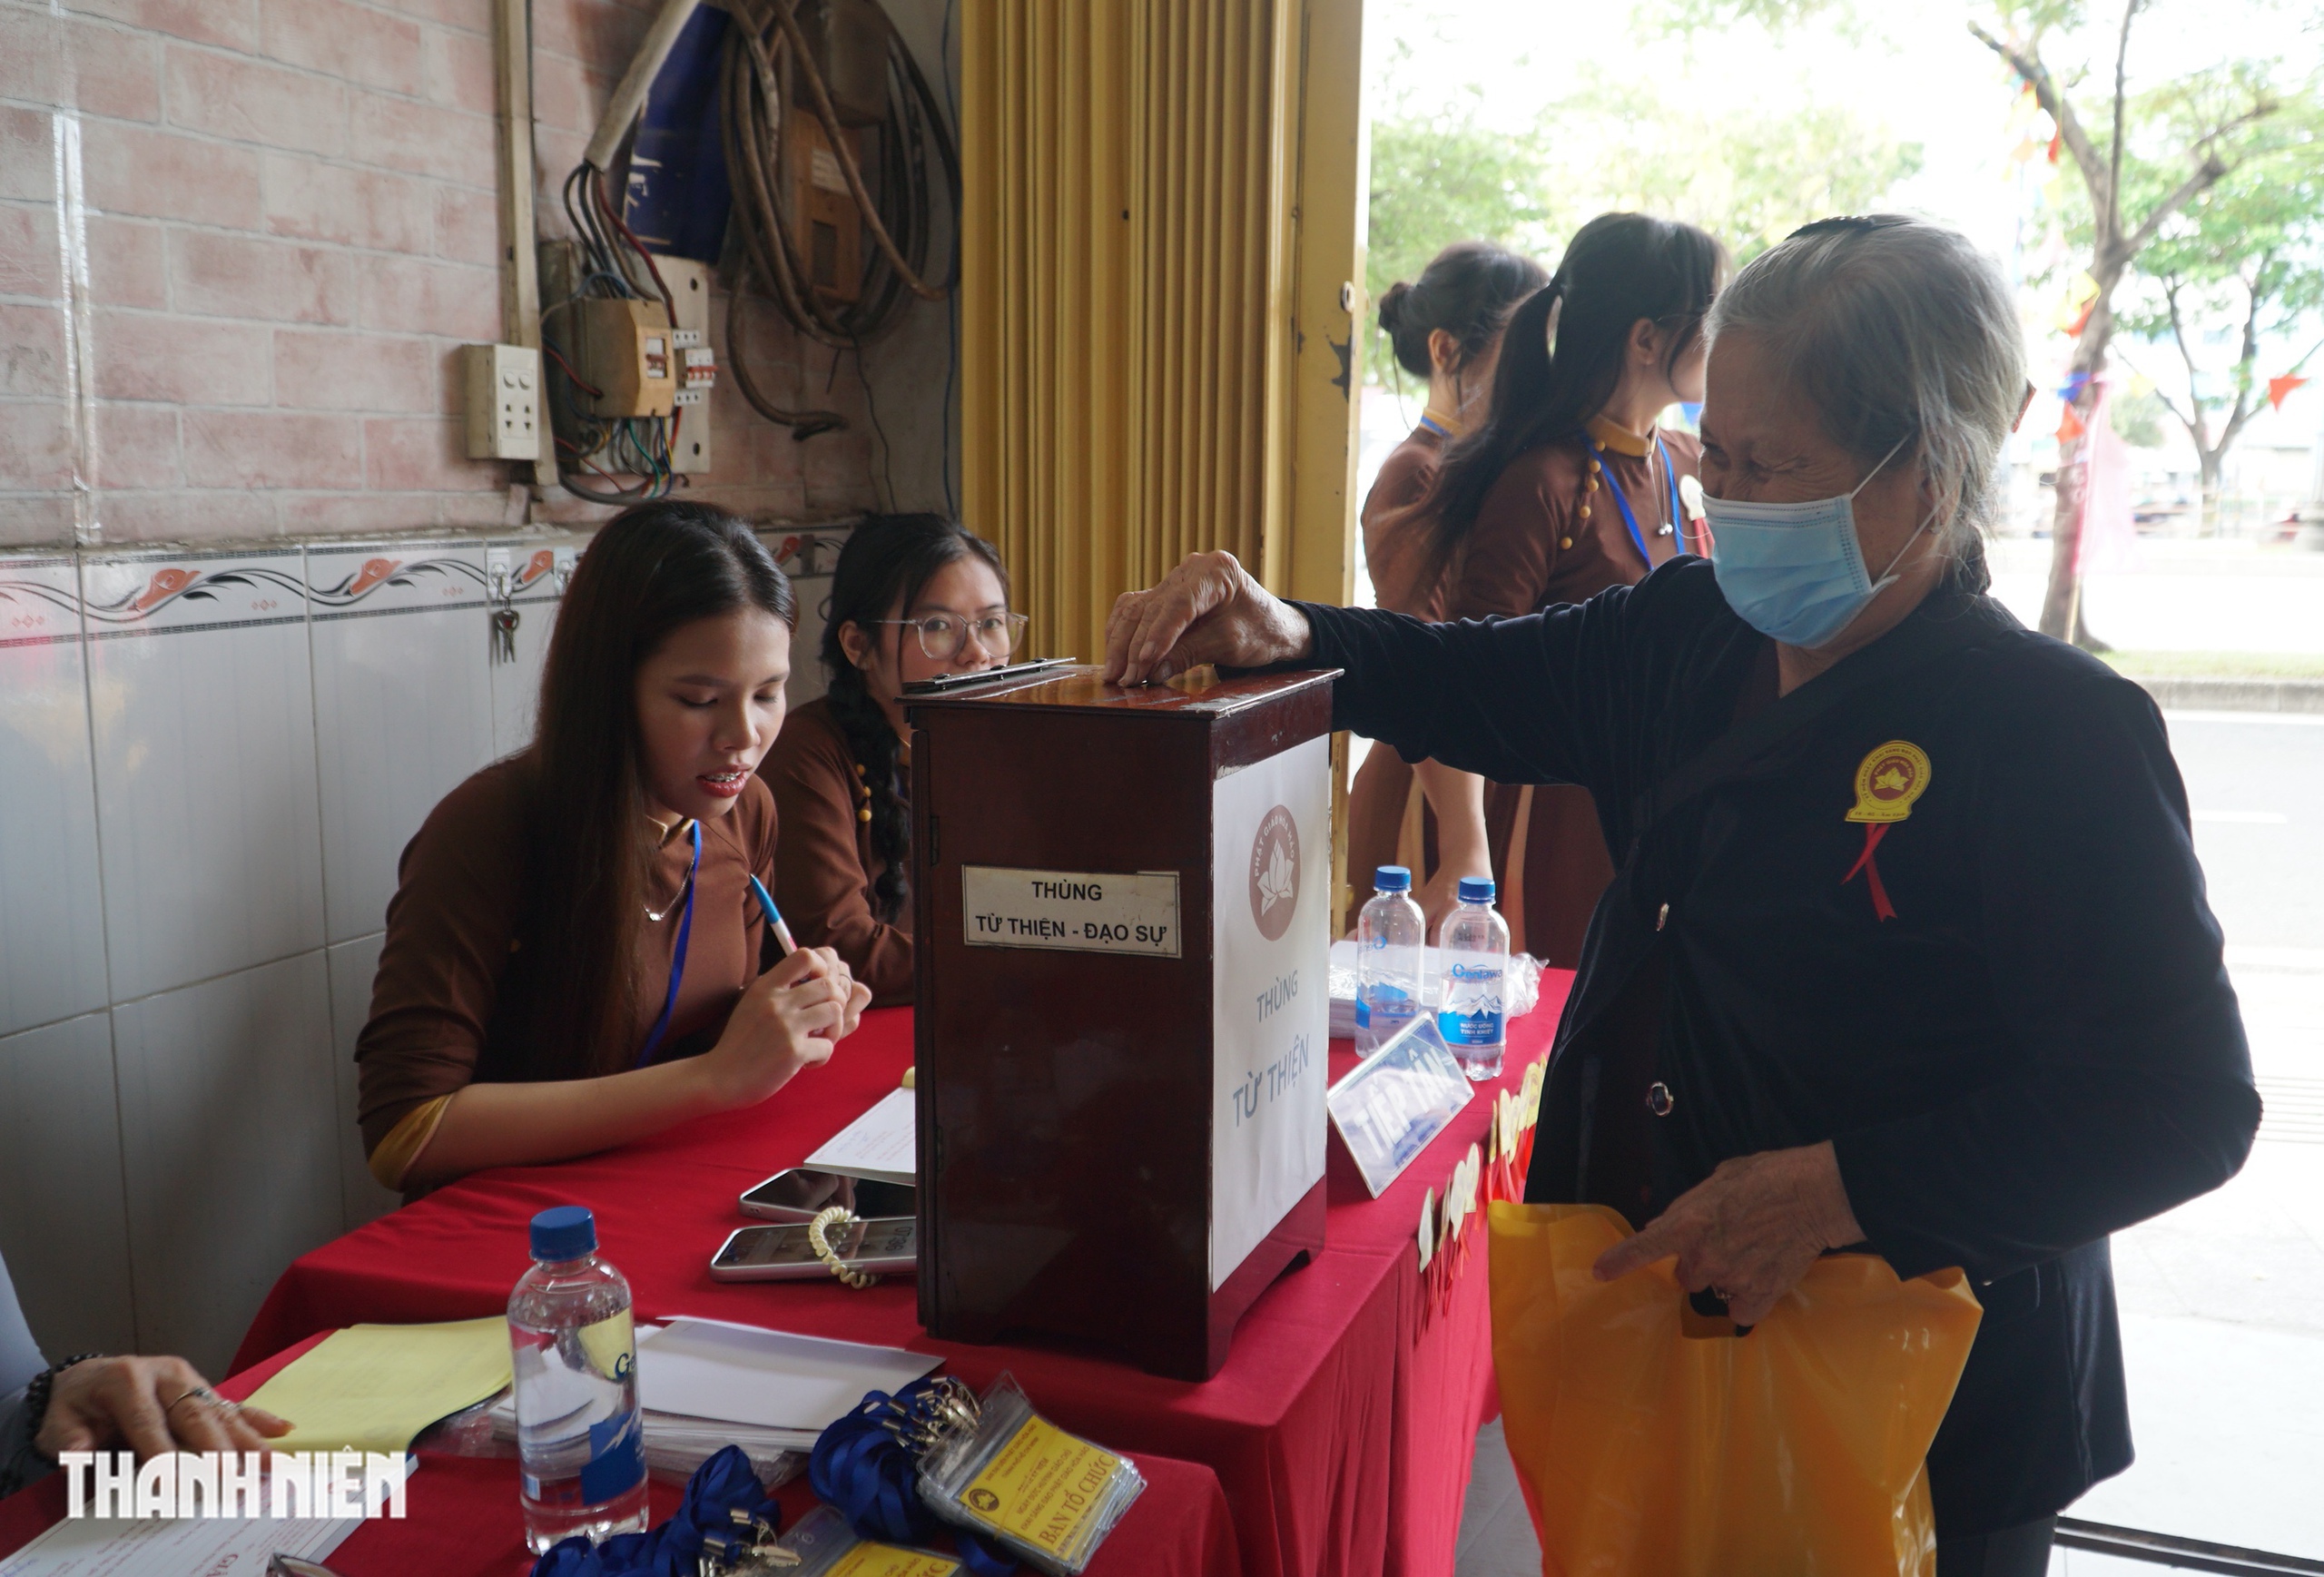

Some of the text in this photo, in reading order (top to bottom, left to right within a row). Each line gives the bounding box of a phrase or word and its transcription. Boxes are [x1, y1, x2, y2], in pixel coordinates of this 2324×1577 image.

[1031, 879, 1102, 902] THÙNG
[975, 913, 1002, 932] TỪ
[1007, 917, 1066, 940] THIỆN
[1084, 922, 1128, 943] ĐẠO
[1135, 925, 1167, 946] SỰ
[1256, 970, 1298, 1023] THÙNG
[1233, 1033, 1309, 1128] TỪ THIỆN
[1038, 1511, 1071, 1544] BAN
[1060, 1489, 1086, 1513] TỔ
[1078, 1454, 1115, 1493] CHỨC
